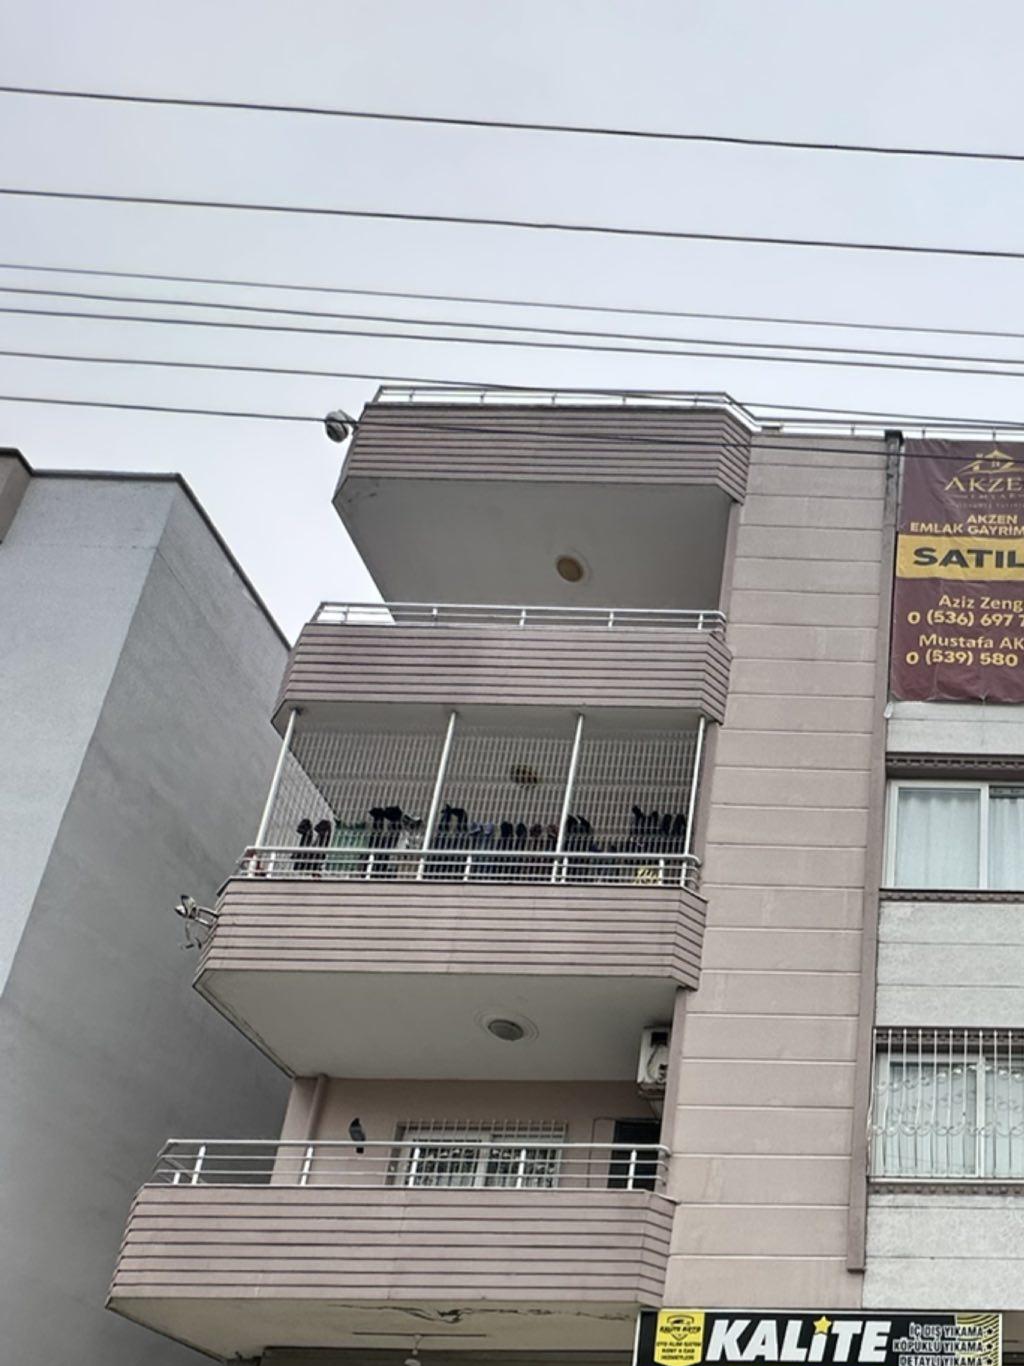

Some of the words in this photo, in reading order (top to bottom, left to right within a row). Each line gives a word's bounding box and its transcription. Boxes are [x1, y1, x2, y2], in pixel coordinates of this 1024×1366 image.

[967, 514, 1018, 524] AKZEN
[910, 522, 963, 534] EMLAK
[938, 595, 975, 609] Aziz
[907, 611, 921, 625] 0
[927, 609, 974, 627] (536)
[980, 613, 1014, 627] 697
[919, 634, 993, 648] Mustafa
[906, 651, 919, 665] 0
[926, 649, 973, 666] (539)
[980, 653, 1018, 667] 580
[943, 1325, 983, 1338] YIKAMA
[942, 1340, 983, 1353] YIKAMA
